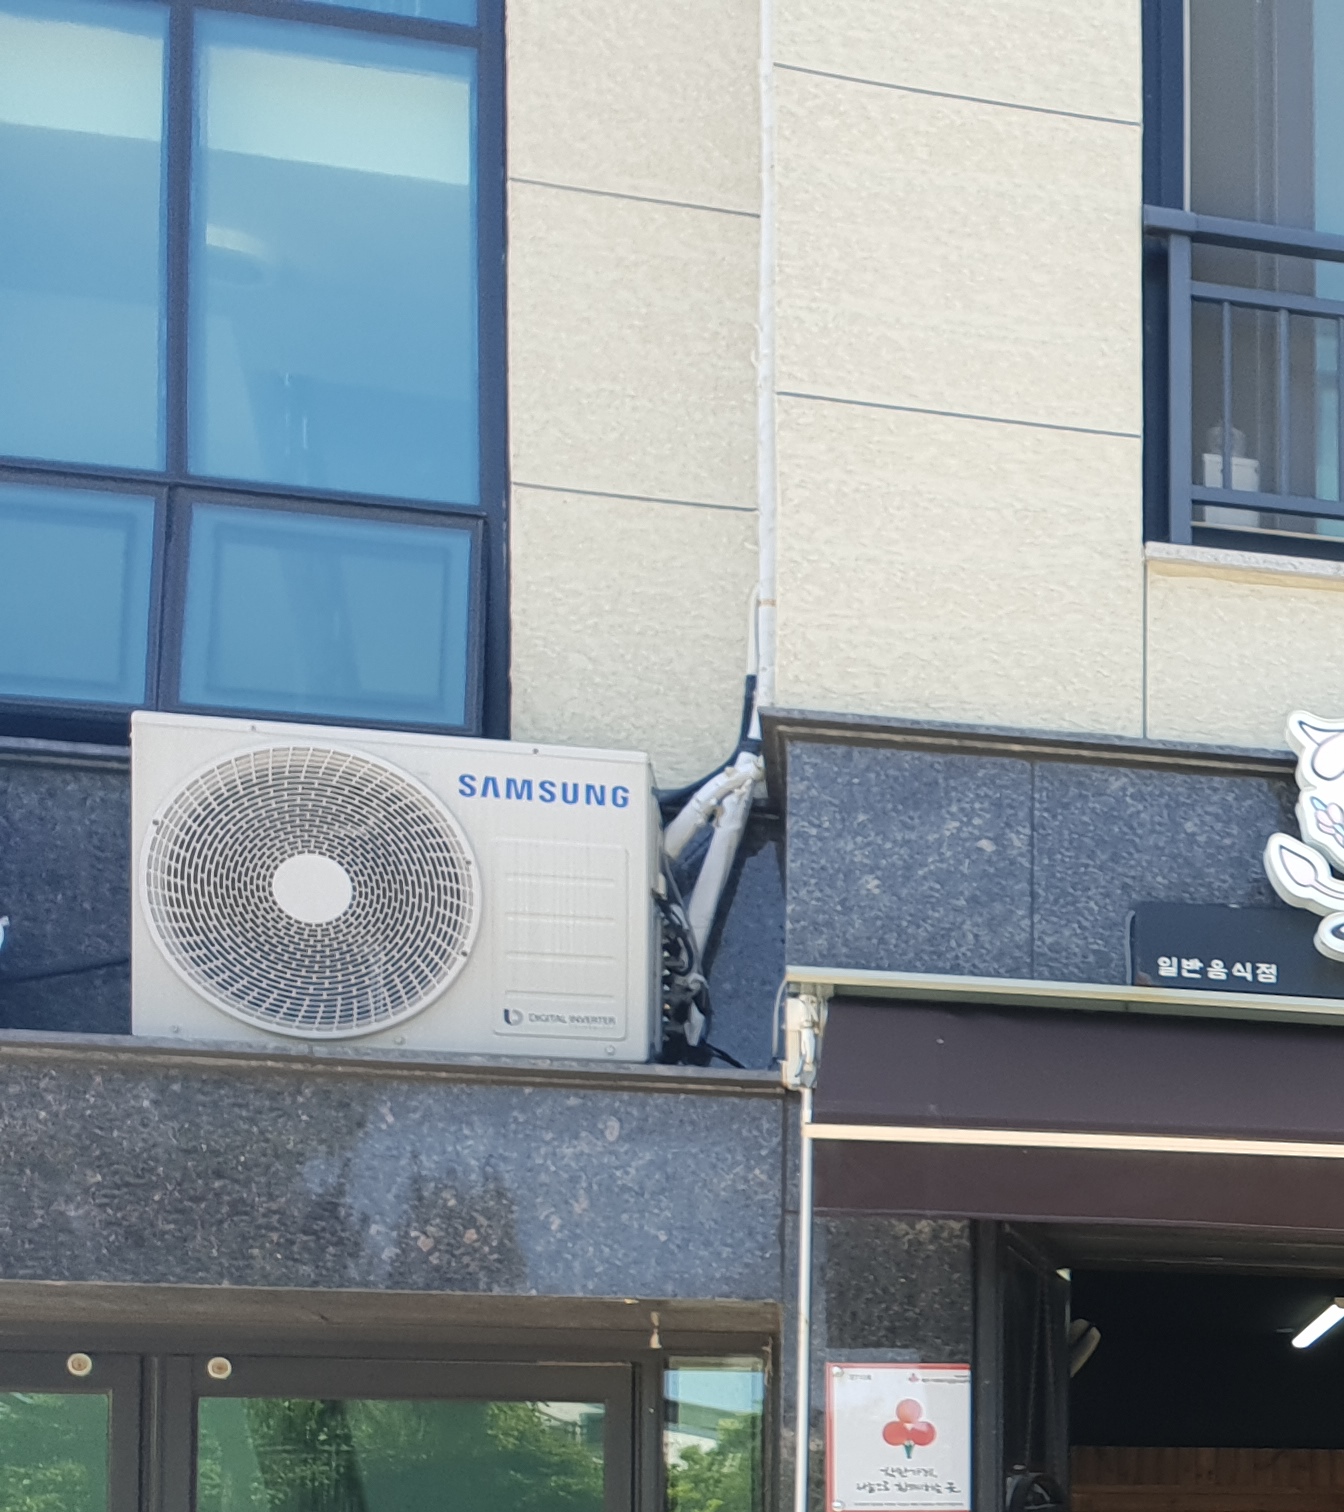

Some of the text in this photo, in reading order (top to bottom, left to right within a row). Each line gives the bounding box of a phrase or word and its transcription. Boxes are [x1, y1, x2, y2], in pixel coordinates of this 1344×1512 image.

[458, 773, 630, 807] SAMSUNG
[1157, 956, 1278, 983] 일반음식점
[528, 1012, 616, 1026] DIGITAL INVERTER
